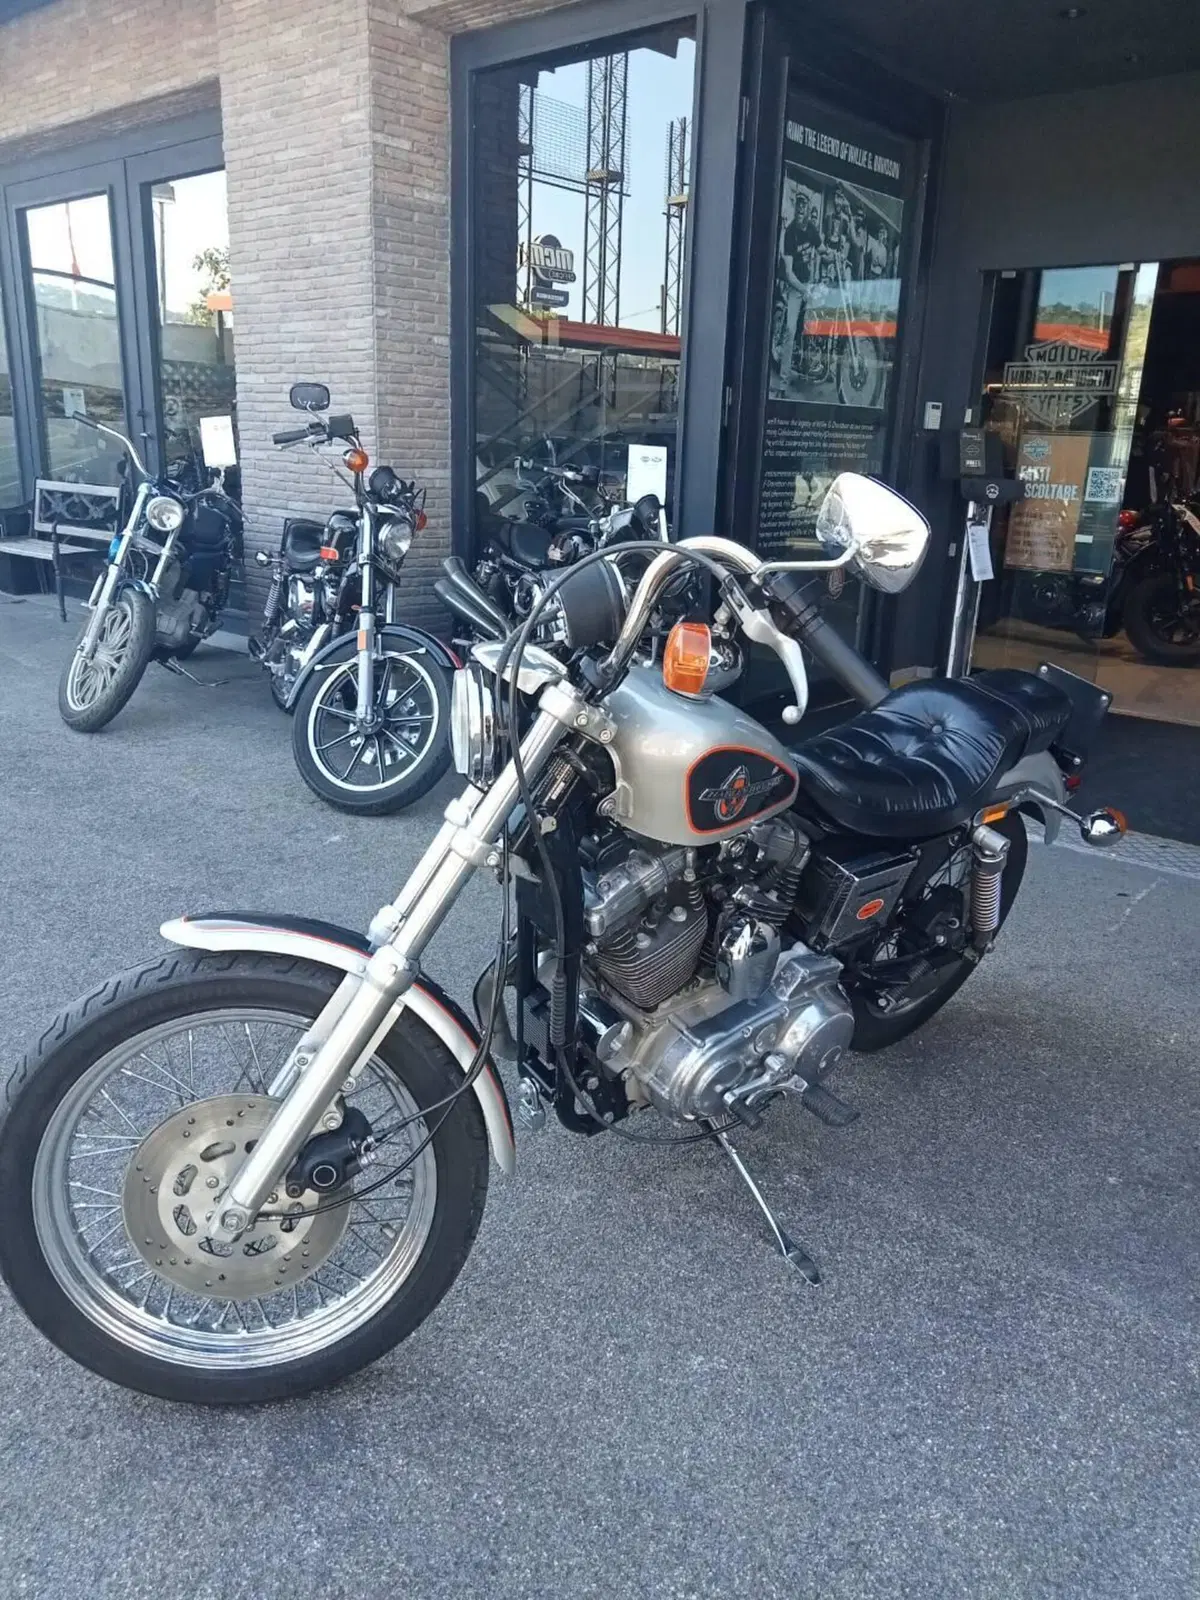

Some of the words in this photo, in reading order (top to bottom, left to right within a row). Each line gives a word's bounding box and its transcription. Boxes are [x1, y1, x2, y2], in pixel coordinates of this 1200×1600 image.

[804, 127, 817, 149] THE
[817, 132, 840, 158] LEGEND
[1036, 345, 1091, 362] MOTOR
[1010, 368, 1112, 387] HARLEY-DAVIDSON
